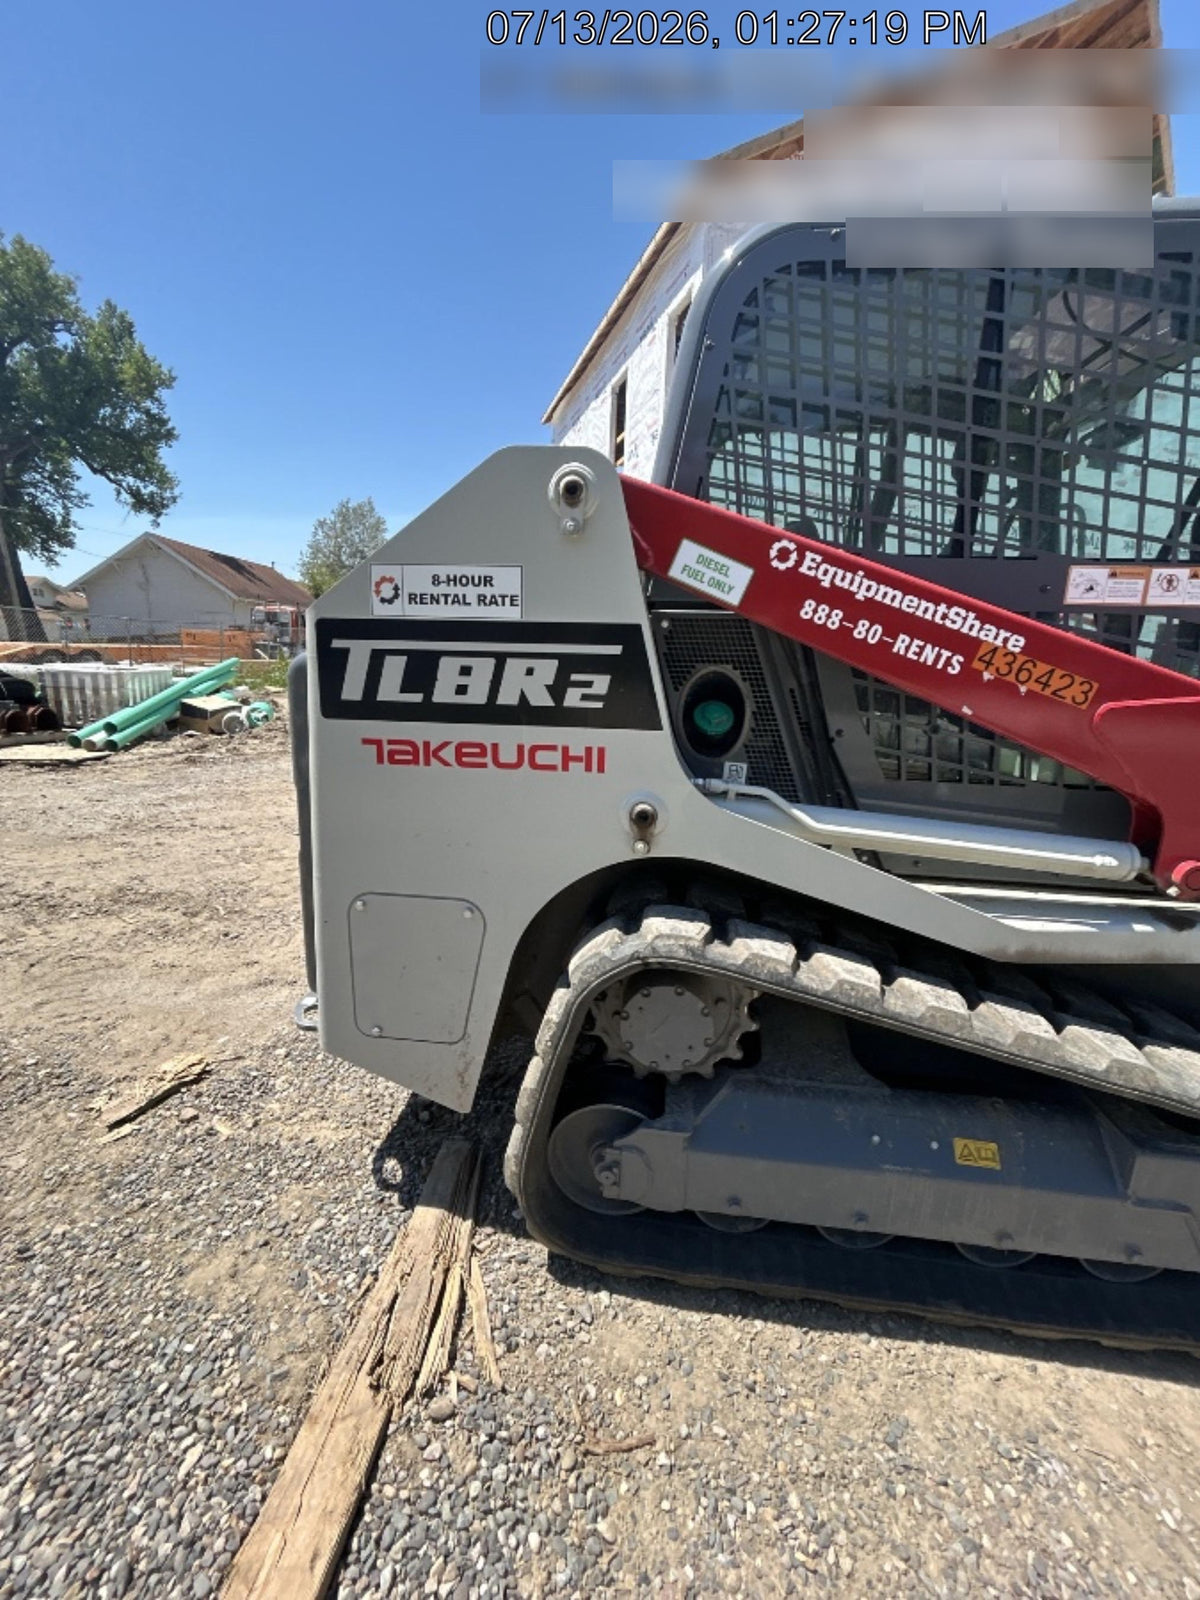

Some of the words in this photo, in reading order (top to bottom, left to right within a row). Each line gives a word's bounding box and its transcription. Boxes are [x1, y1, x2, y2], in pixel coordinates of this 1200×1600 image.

[431, 574, 494, 588] 8-HOUR
[681, 564, 706, 584] FUEL
[707, 576, 735, 595] ONLY
[696, 553, 730, 578] DIESEL
[407, 592, 472, 607] RENTAL
[476, 594, 520, 607] RATE
[798, 551, 1026, 653] EquipmentShare
[799, 599, 965, 675] 888-80-RENTS
[331, 639, 623, 709] TL8R2
[977, 645, 1094, 705] 436423
